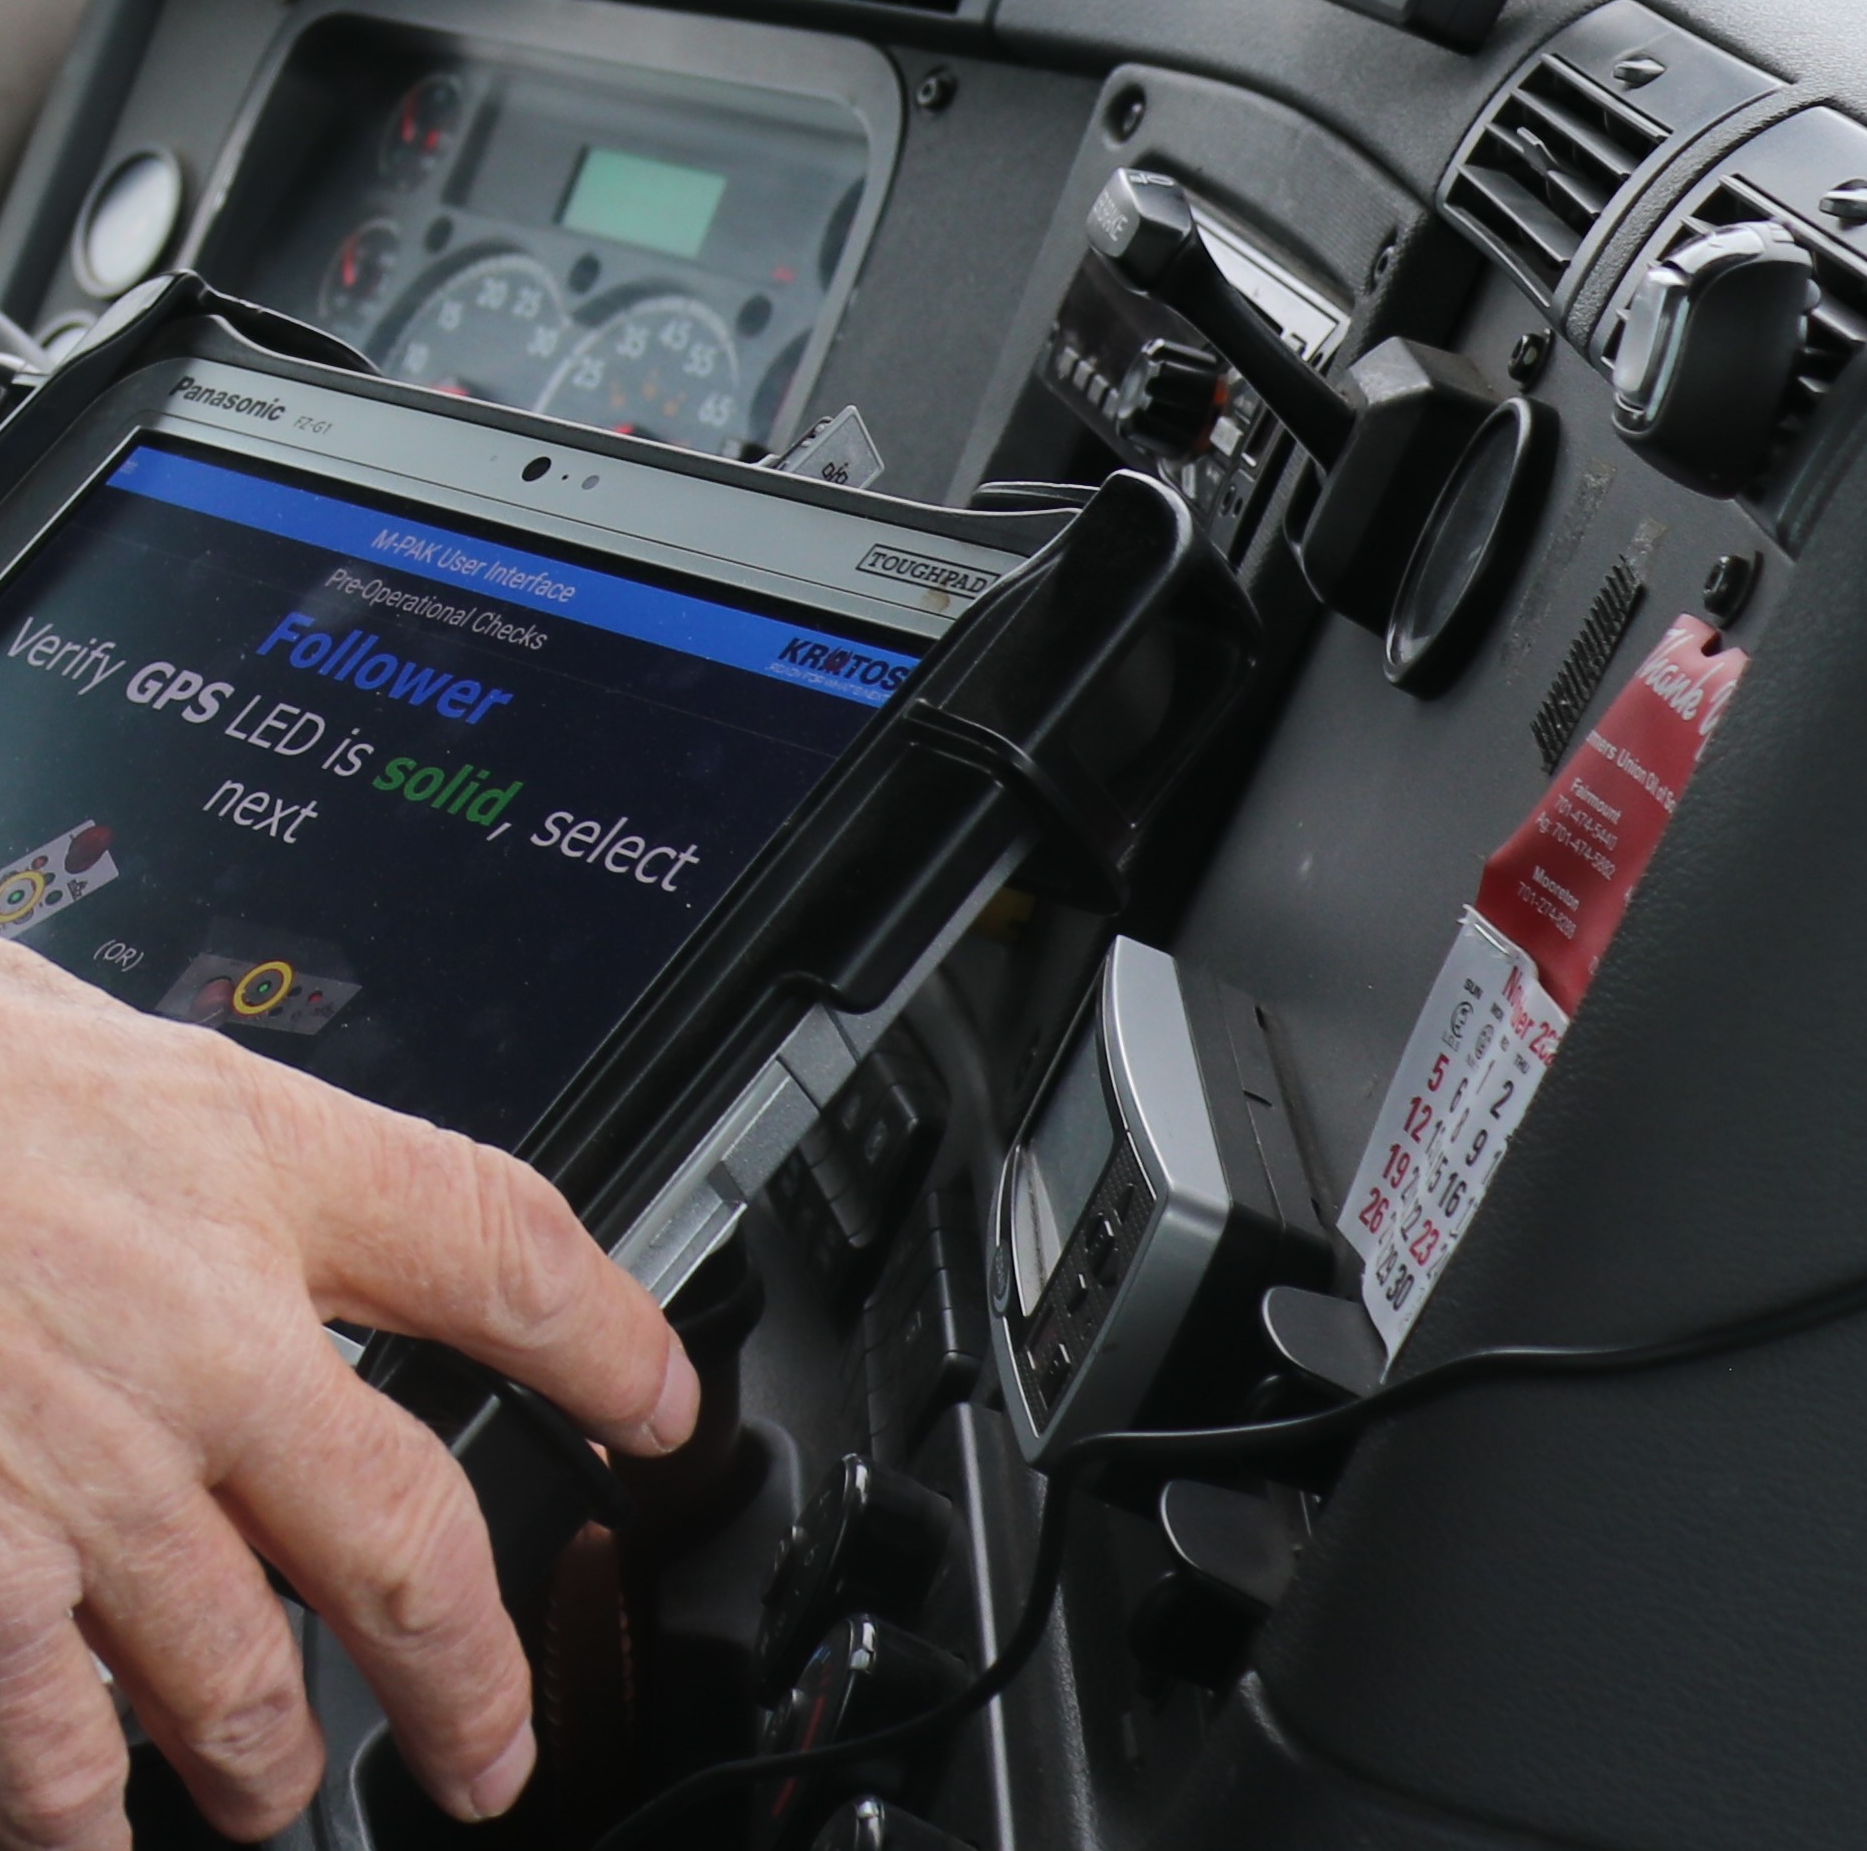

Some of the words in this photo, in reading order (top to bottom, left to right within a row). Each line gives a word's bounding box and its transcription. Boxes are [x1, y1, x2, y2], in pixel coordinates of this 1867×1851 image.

[169, 375, 286, 422] Panasonic
[293, 415, 334, 436] FZ-G1
[370, 528, 441, 564] M-PAK
[436, 546, 488, 578] User
[483, 560, 577, 604] Interface
[867, 550, 988, 595] TOUGHPAD
[324, 567, 477, 629] Pre-Operational
[471, 611, 549, 651] Checks
[255, 611, 514, 725] Follower
[777, 636, 910, 692] KRATOS
[1635, 628, 1725, 721] Thank
[6, 616, 127, 697] Verify
[124, 660, 236, 724] GPS
[224, 693, 326, 757] LED
[321, 727, 376, 778] is
[371, 756, 525, 842] solid,
[529, 810, 701, 893] select
[1616, 748, 1647, 785] Union
[202, 777, 320, 845] next
[1571, 777, 1622, 825] Fairmount
[93, 937, 145, 972] (OR)
[1464, 978, 1484, 1000] SUN
[1514, 1052, 1531, 1074] THU
[1427, 1052, 1451, 1093] 5
[1449, 1077, 1468, 1113] 6
[1465, 1129, 1488, 1168] 9
[1489, 1079, 1515, 1120] 2
[1403, 1096, 1434, 1144] 12
[1438, 1171, 1468, 1218] 16
[1382, 1143, 1412, 1190] 19
[1408, 1219, 1441, 1267] 23
[1358, 1186, 1390, 1235] 26
[1385, 1264, 1415, 1312] 30
